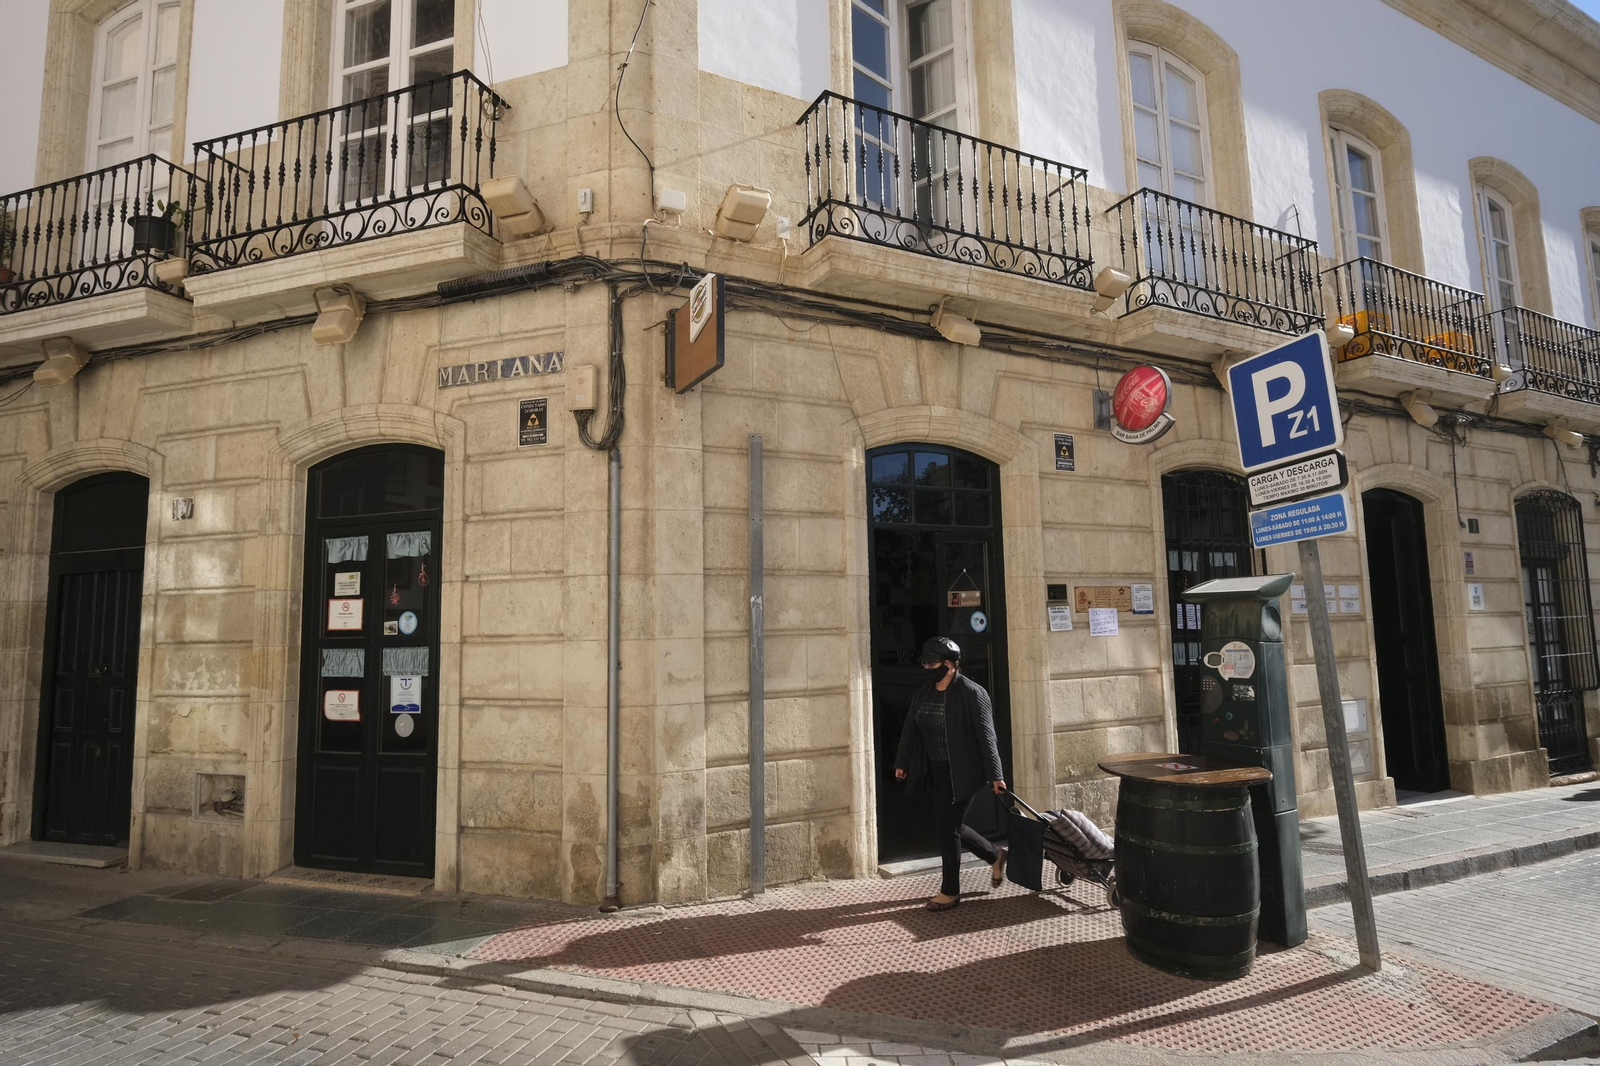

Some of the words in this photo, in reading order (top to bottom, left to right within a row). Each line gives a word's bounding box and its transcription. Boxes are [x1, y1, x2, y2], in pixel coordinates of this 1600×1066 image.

[438, 352, 562, 387] MARIANA
[1251, 360, 1306, 448] P
[1116, 430, 1124, 438] BAR
[1146, 420, 1161, 435] PALMA
[1287, 405, 1320, 440] Z1
[1251, 473, 1278, 486] CARGA
[1279, 471, 1285, 479] Y
[1286, 458, 1334, 477] DESCARGA
[1255, 484, 1290, 497] LUNES-VIERNES
[1263, 492, 1280, 500] TIEMPO
[1280, 488, 1299, 498] MAXIMO
[1306, 480, 1328, 490] MINUTOS
[1270, 513, 1286, 522] ZONA
[1288, 504, 1320, 518] REGULADA
[1255, 521, 1292, 534] LUNES-SÁBADO
[1301, 516, 1316, 525] 11:00
[1256, 530, 1294, 542] LUNES-VIERNES
[1303, 526, 1317, 534] 19:00
[1323, 522, 1339, 530] 20:30
